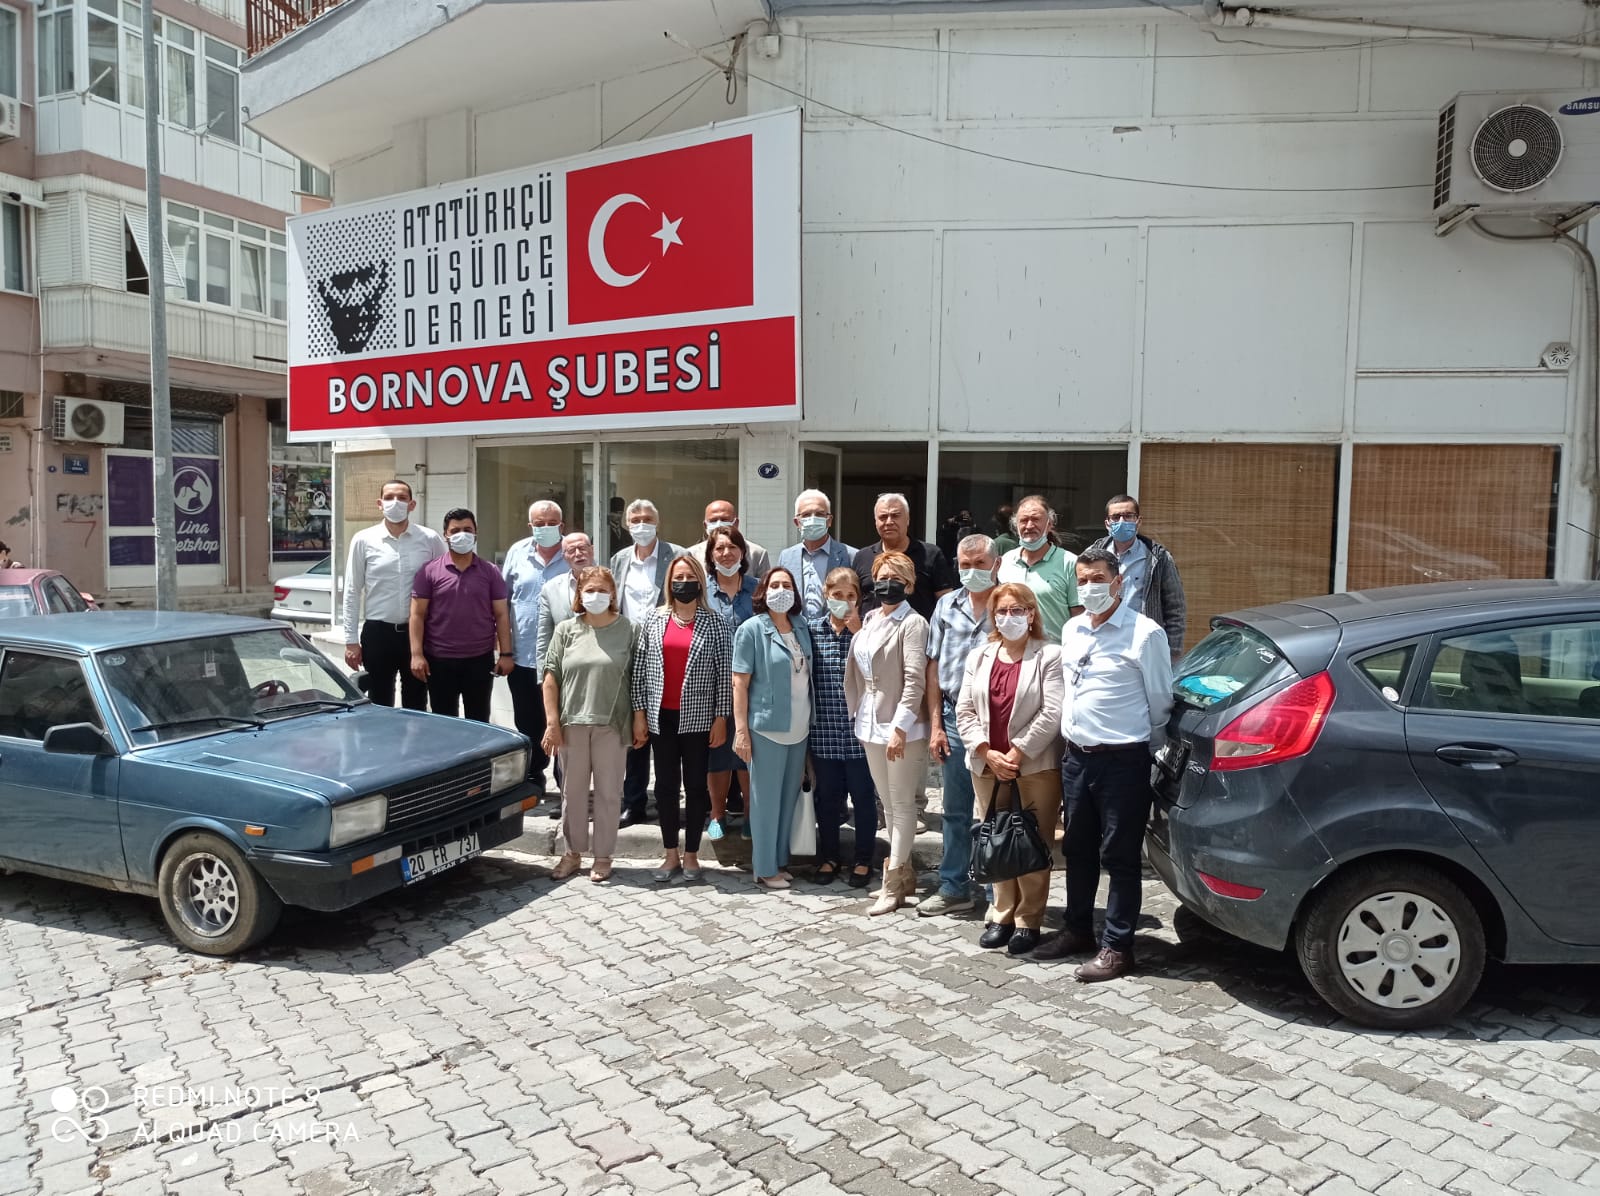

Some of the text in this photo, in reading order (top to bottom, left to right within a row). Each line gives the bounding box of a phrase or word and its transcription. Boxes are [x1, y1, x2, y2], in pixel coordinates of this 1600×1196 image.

[403, 172, 553, 249] ATATÜRKÇÜ
[403, 235, 554, 299] DÜŞÜNCE
[403, 282, 555, 348] DERNEĞİ
[328, 330, 721, 415] BORNOVA ŞUBESİ
[176, 520, 210, 535] Lina
[176, 537, 220, 554] etshop
[409, 854, 426, 876] 20
[432, 846, 449, 867] FR
[456, 833, 478, 856] 737
